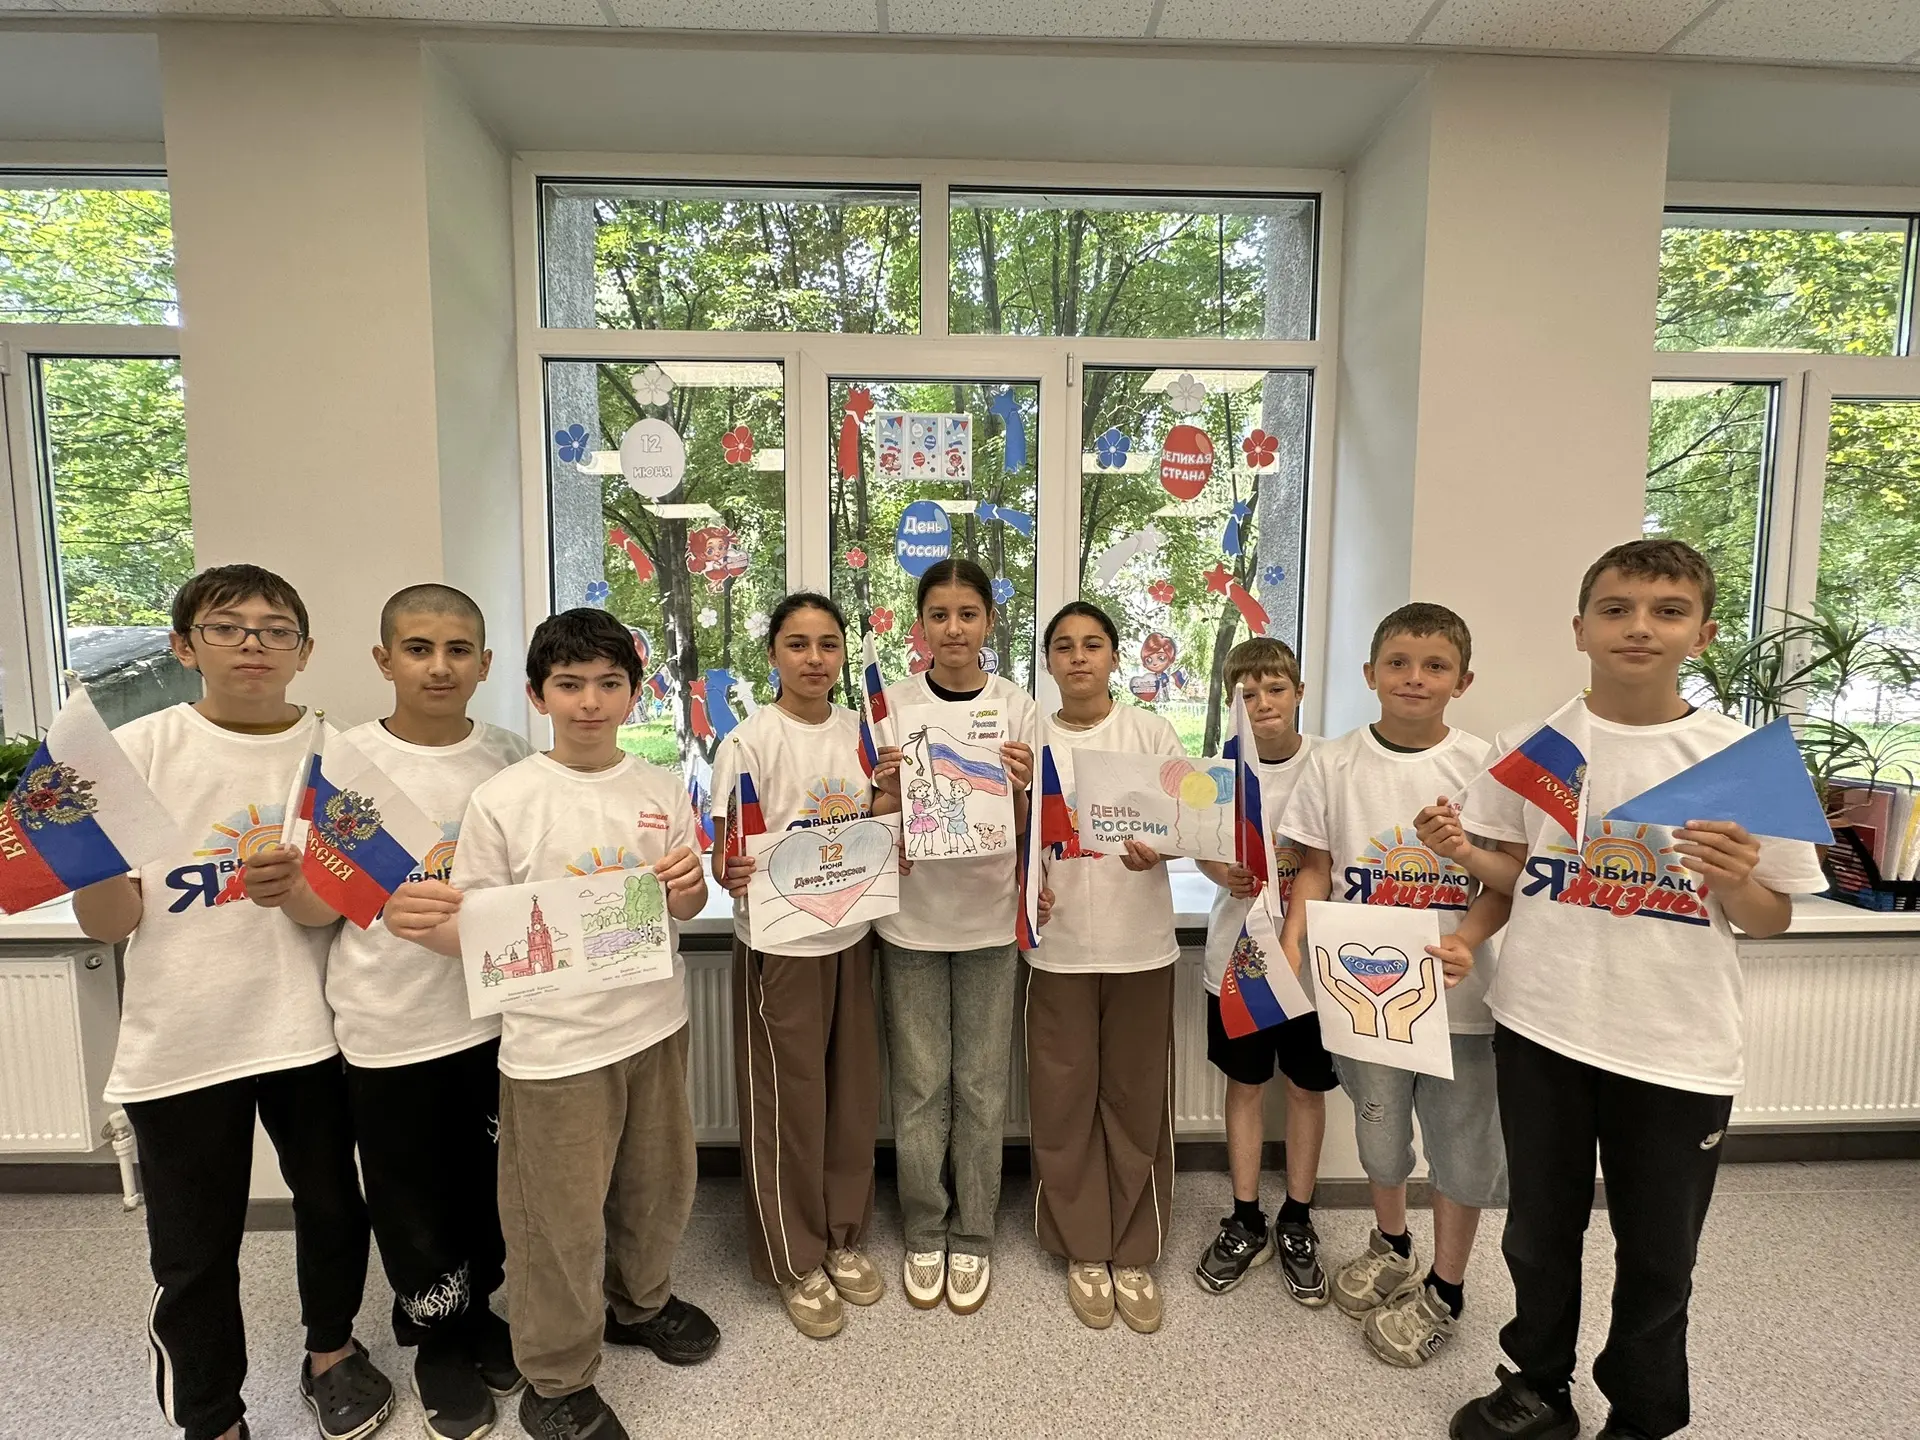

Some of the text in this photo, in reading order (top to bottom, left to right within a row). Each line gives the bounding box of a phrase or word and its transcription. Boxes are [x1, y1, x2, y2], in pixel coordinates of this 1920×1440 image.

[641, 434, 662, 453] 12
[1162, 466, 1206, 481] СТРАНА
[903, 515, 942, 535] День
[897, 539, 948, 557] России
[1536, 775, 1580, 820] РОСС
[1090, 804, 1140, 818] ДЕНЬ
[1092, 819, 1168, 836] РОССИИ
[1106, 834, 1134, 842] ИЮНЯ
[308, 829, 356, 881] ОССИЯ
[819, 843, 843, 863] 12
[794, 866, 866, 889] День России
[1344, 866, 1470, 904] Я ВЫБИРАЮ
[1522, 856, 1566, 901] Я
[165, 863, 220, 913] Я
[1345, 955, 1403, 974] РОССИЯ
